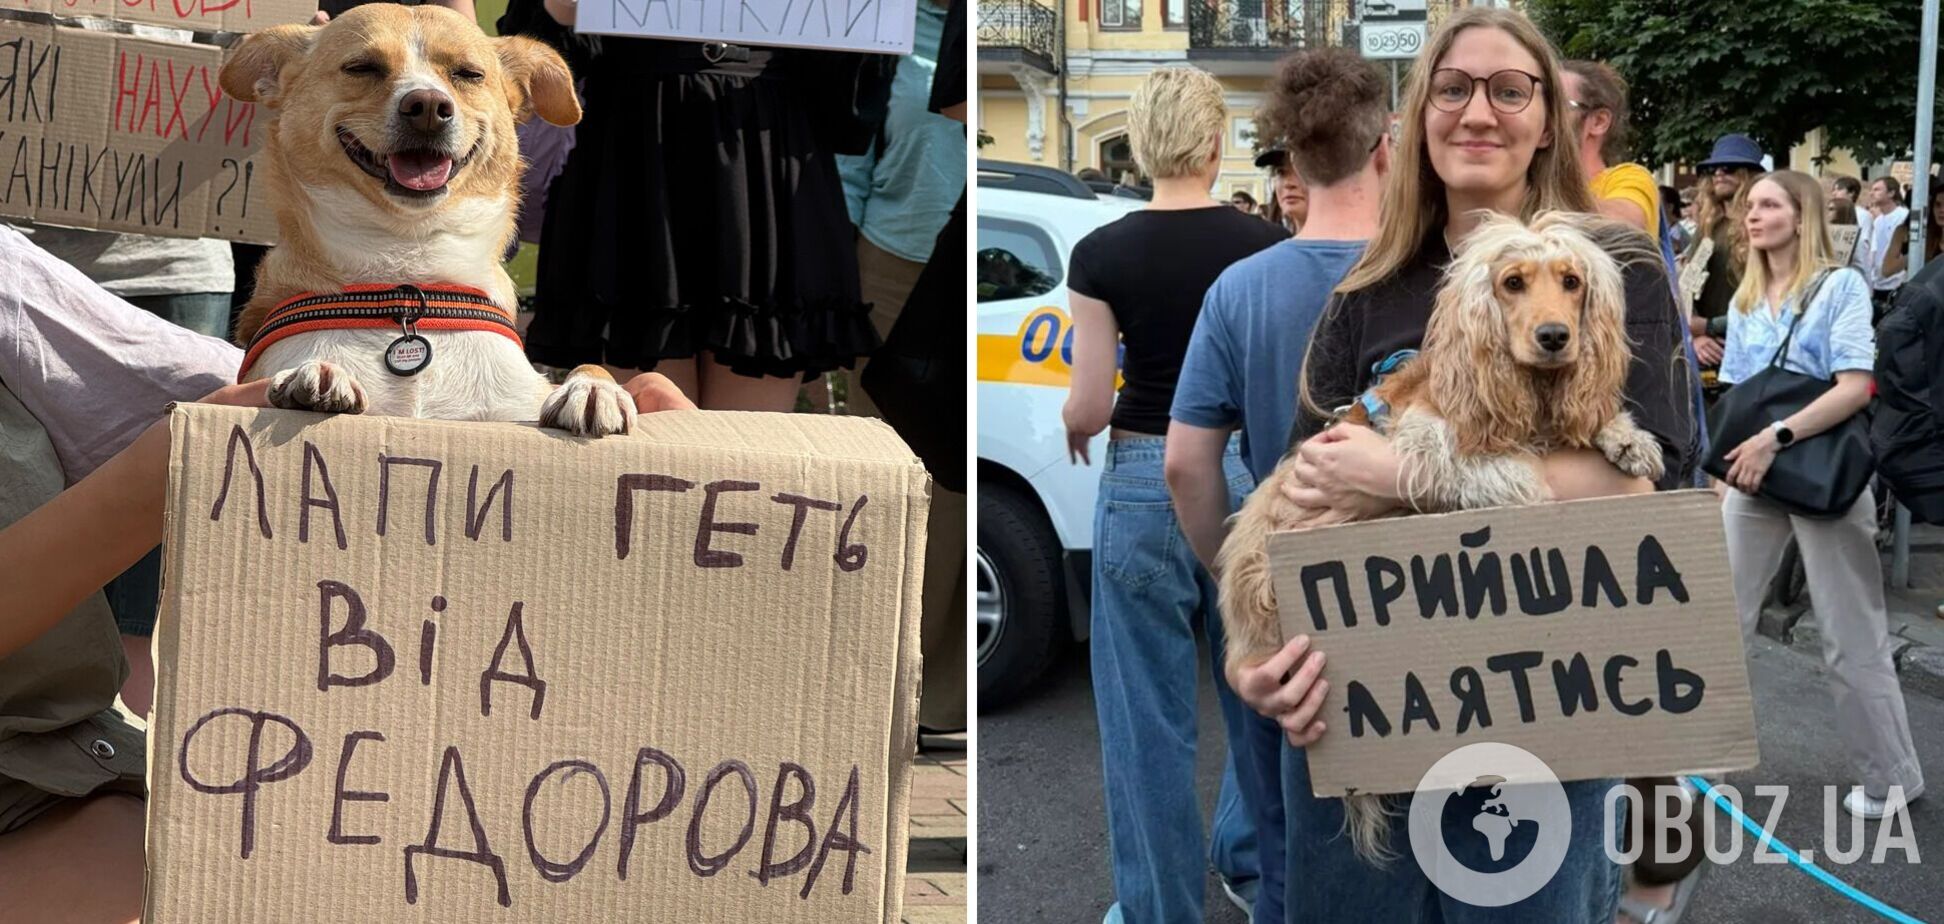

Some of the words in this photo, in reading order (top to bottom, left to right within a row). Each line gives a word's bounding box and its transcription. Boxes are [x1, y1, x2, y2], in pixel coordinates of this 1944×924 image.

[1368, 37, 1379, 47] 10
[1383, 36, 1396, 47] 25
[1400, 33, 1417, 47] 50
[0, 130, 184, 229] АНІКУЛИ
[210, 425, 514, 550] ЛАПИ
[615, 473, 869, 572] ГЕТЬ
[1300, 525, 1691, 631] ПРИЙШЛА
[1342, 647, 1706, 738] ЛАЯТИСЬ
[178, 707, 871, 906] ФЕДОРОВА
